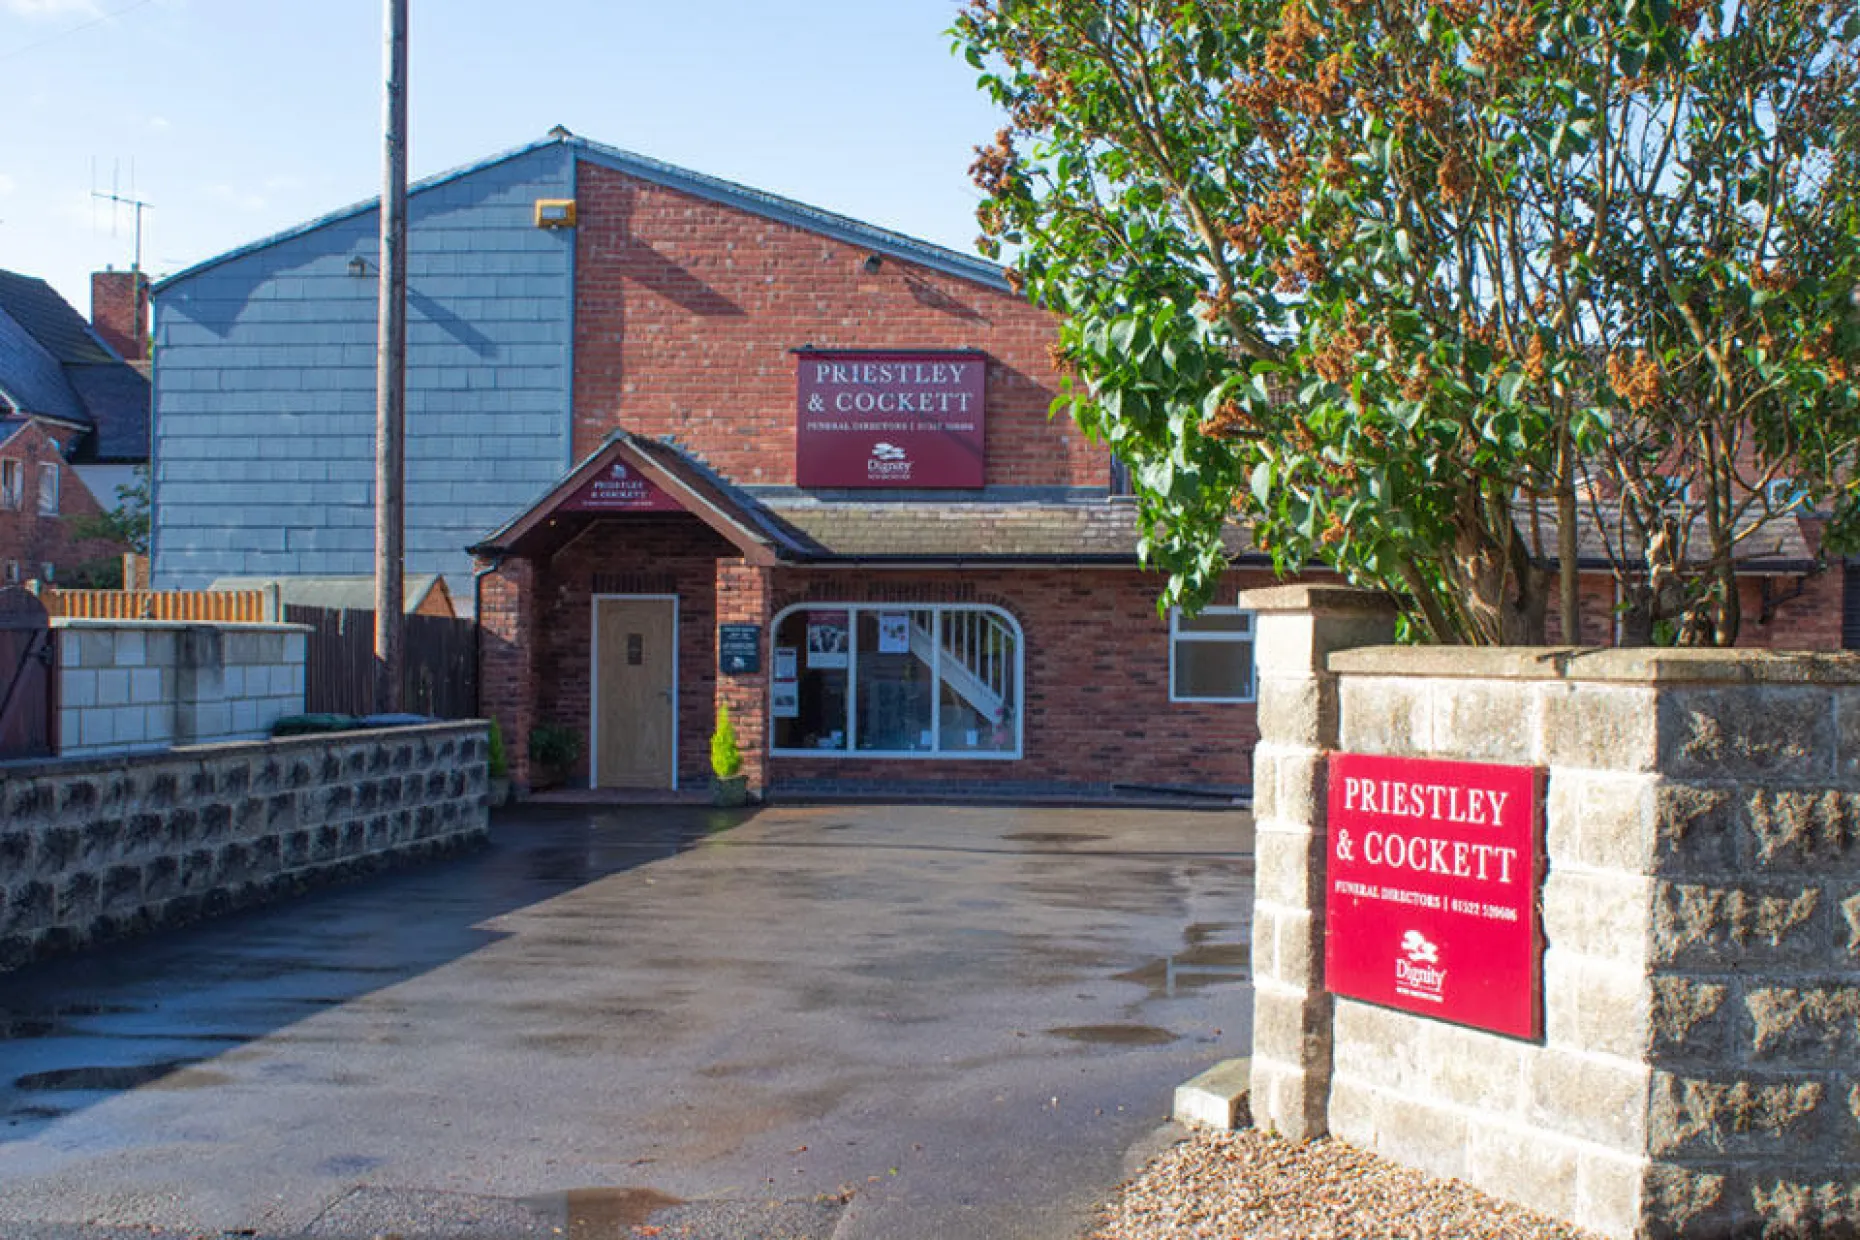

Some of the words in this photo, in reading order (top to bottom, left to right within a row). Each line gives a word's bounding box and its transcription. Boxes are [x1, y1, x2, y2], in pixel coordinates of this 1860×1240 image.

[815, 363, 966, 384] PRIESTLEY
[807, 392, 825, 412] &
[836, 392, 973, 412] COCKETT
[1344, 777, 1509, 827] PRIESTLEY
[1336, 828, 1355, 861] &
[1363, 831, 1518, 883] COCKETT
[1335, 879, 1380, 899] FUNERAL
[1380, 886, 1440, 910] DIRECTORS
[1395, 958, 1448, 993] Dignity
